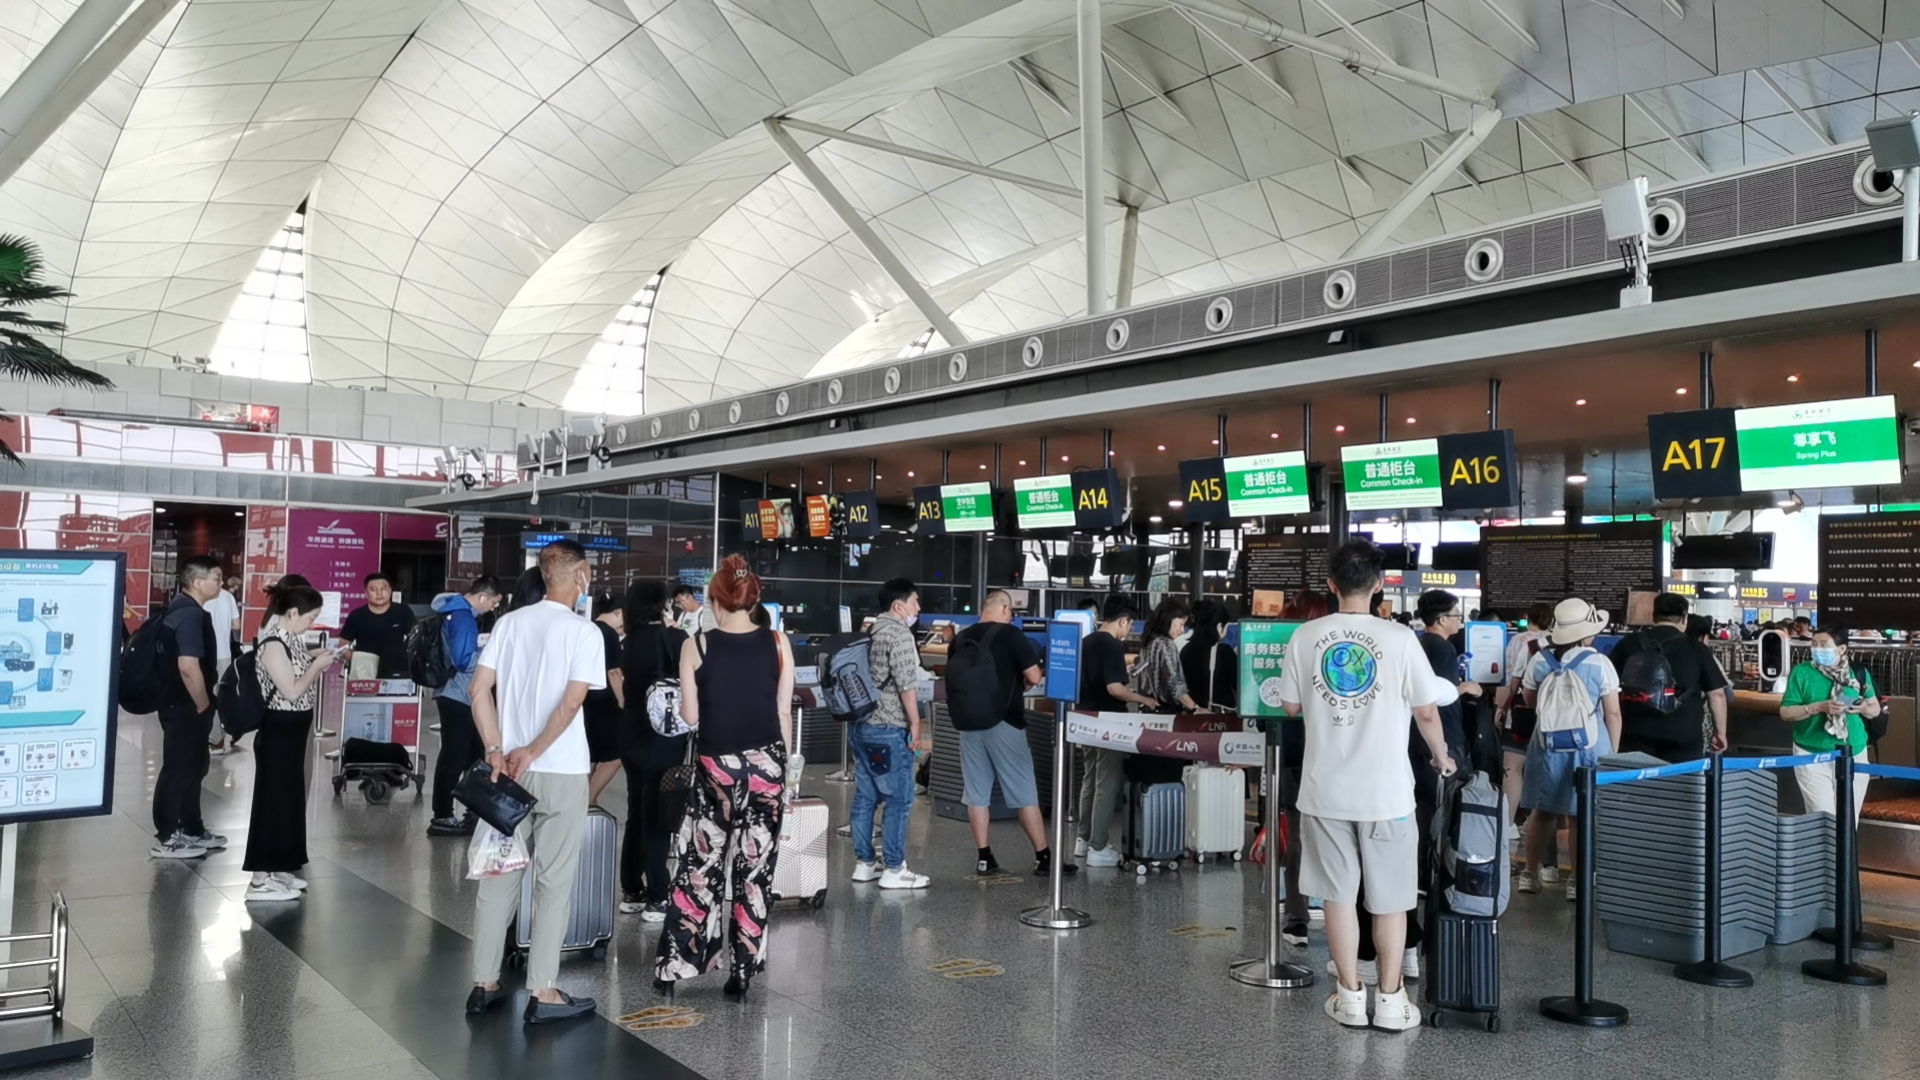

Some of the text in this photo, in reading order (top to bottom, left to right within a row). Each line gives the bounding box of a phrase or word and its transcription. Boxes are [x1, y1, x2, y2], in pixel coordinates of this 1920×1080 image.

[1662, 437, 1726, 472] A17
[1796, 450, 1837, 460] Spring Plus
[1364, 459, 1416, 479] 普通柜台
[1449, 455, 1500, 486] A16
[1243, 470, 1287, 487] 普通柜台
[1360, 477, 1423, 488] Common Check-in
[1028, 490, 1059, 504] 普通柜台
[1078, 487, 1109, 510] A14
[1188, 478, 1222, 502] A15
[1240, 485, 1293, 496] Common Check-in
[849, 505, 869, 523] A12
[919, 501, 941, 520] A13
[1026, 504, 1045, 512] Common
[745, 513, 759, 528] A11
[1314, 629, 1383, 660] THE WORLD
[1312, 675, 1348, 710] NEEDS
[1208, 722, 1227, 732] LNA
[1176, 740, 1198, 753] LNA
